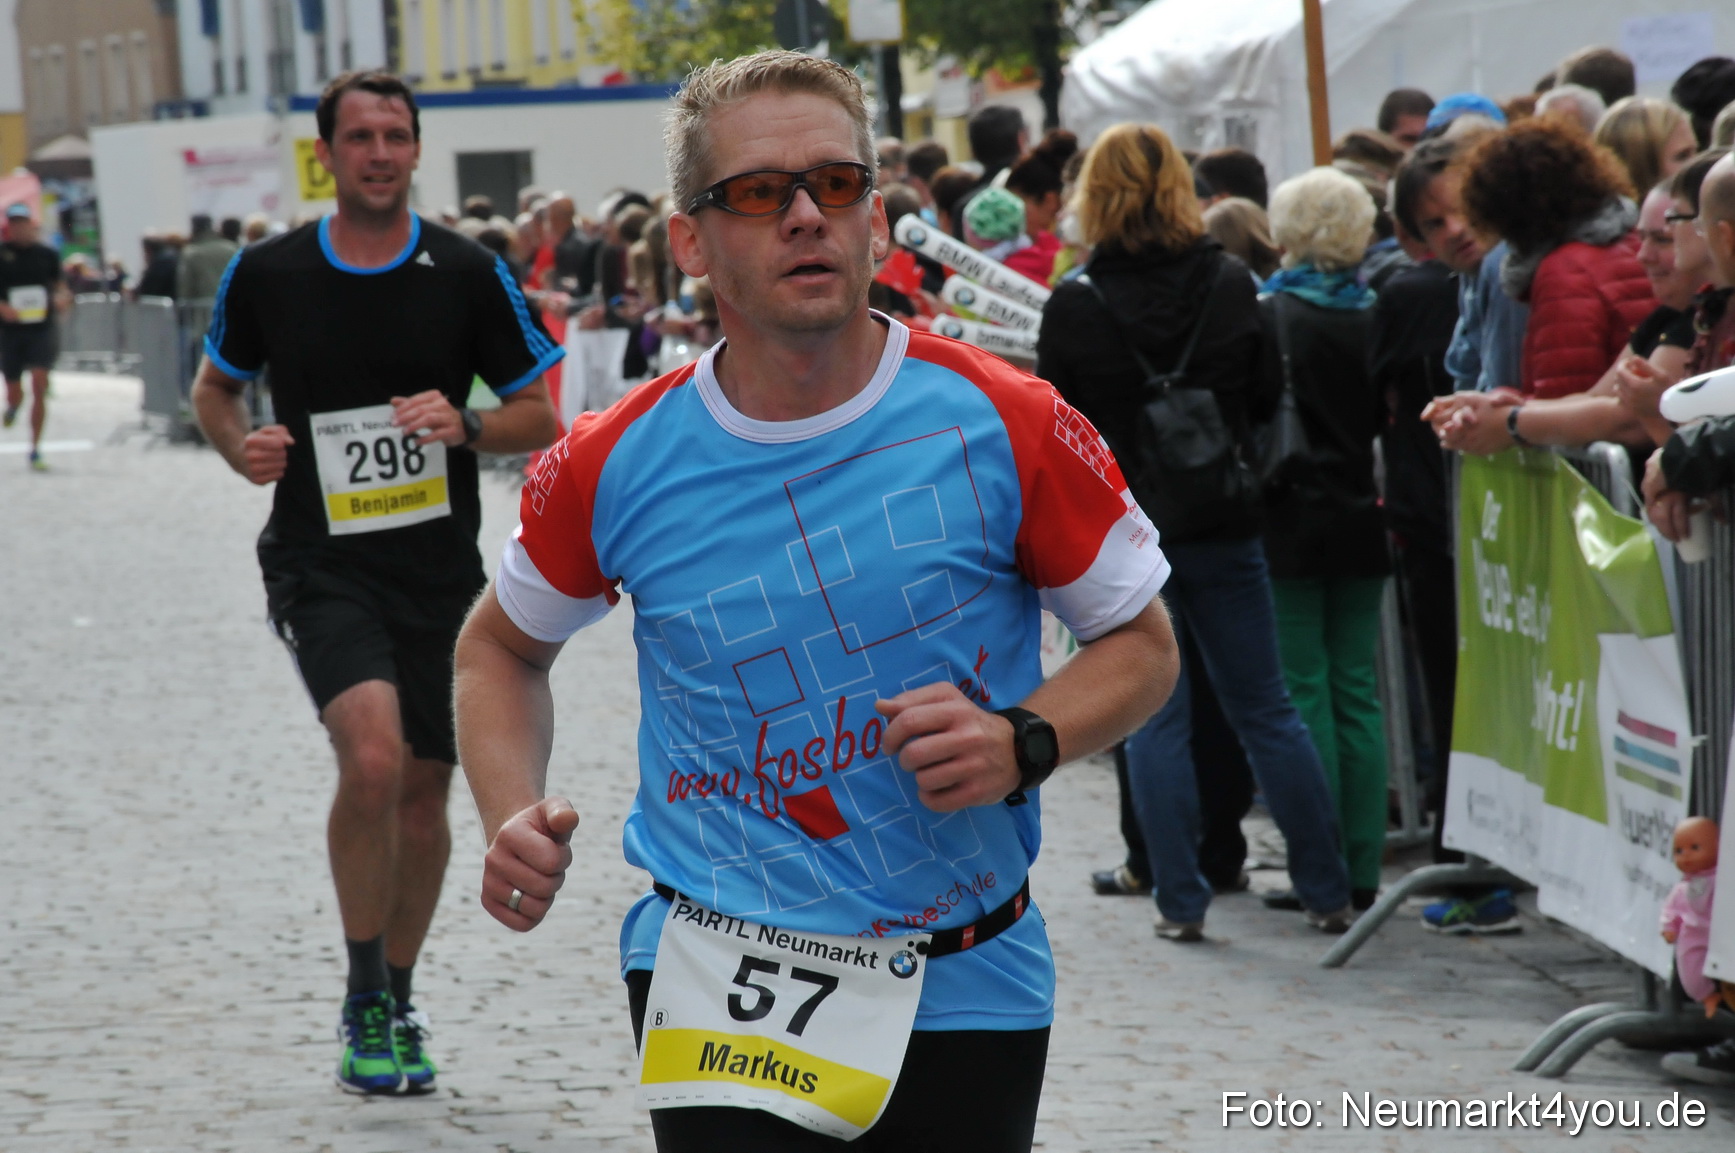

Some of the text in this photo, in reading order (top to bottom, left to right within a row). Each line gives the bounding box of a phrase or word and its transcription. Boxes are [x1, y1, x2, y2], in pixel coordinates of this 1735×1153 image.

[939, 241, 988, 278] BMW
[986, 301, 1036, 331] BMW
[316, 421, 358, 436] PARTL
[345, 433, 426, 484] 298
[350, 489, 428, 515] Benjamin
[672, 903, 878, 970] PARTL Neumarkt
[727, 954, 840, 1037] 57
[698, 1041, 819, 1094] Markus
